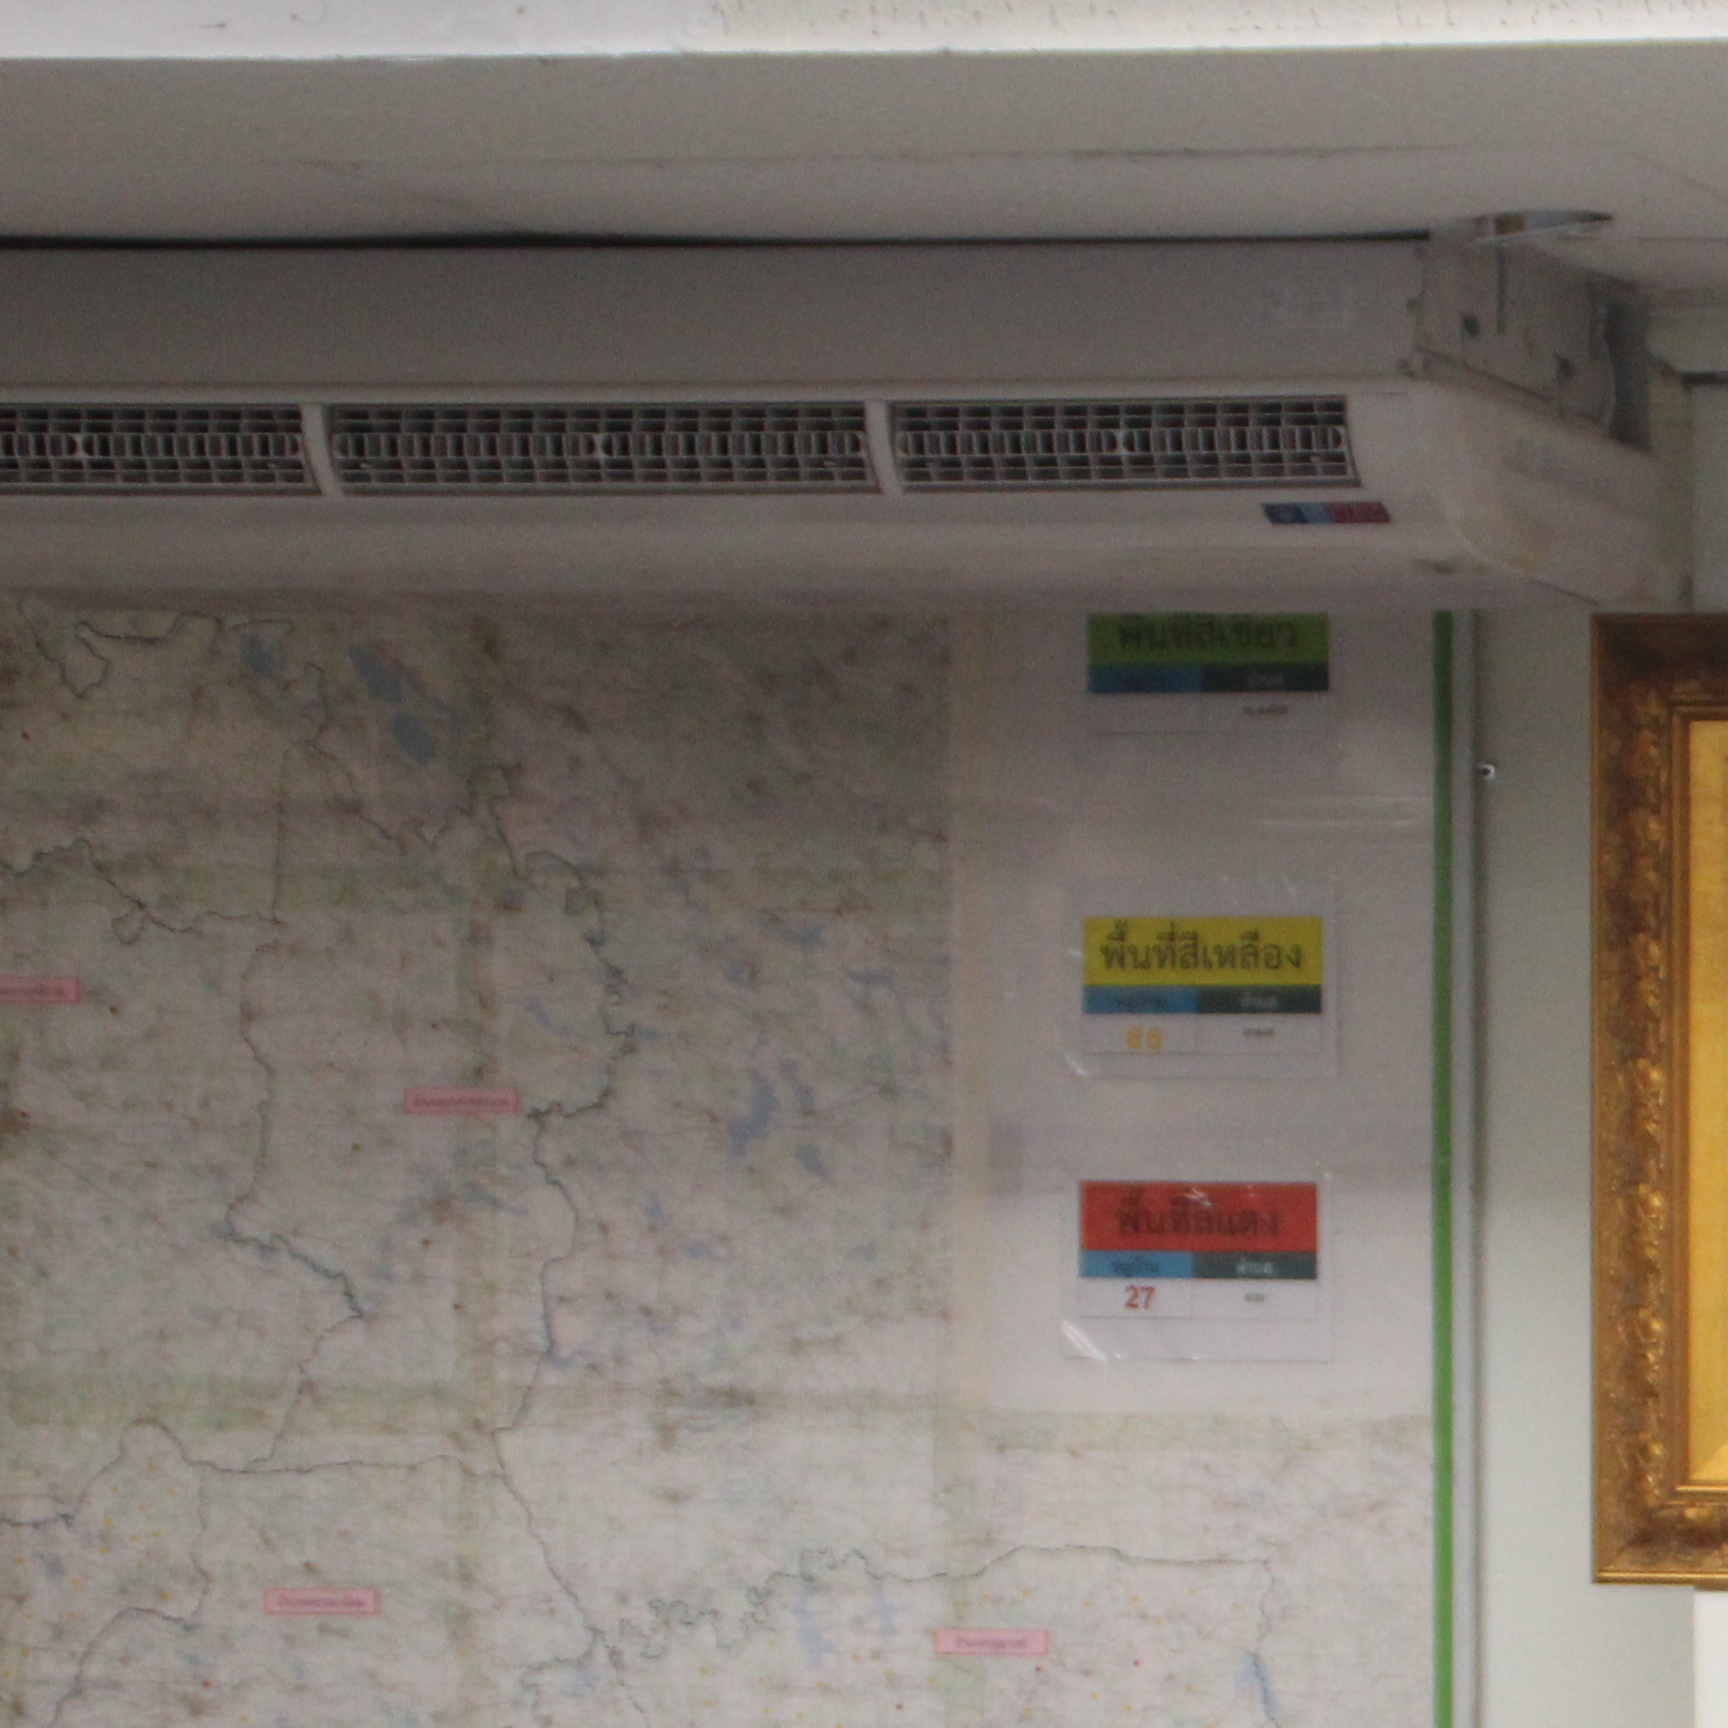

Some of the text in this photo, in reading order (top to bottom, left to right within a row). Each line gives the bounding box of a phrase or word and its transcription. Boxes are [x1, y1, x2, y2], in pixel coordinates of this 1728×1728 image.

[1100, 919, 1303, 970] พื้นที่สีเหลือง
[1124, 1285, 1156, 1309] 27
